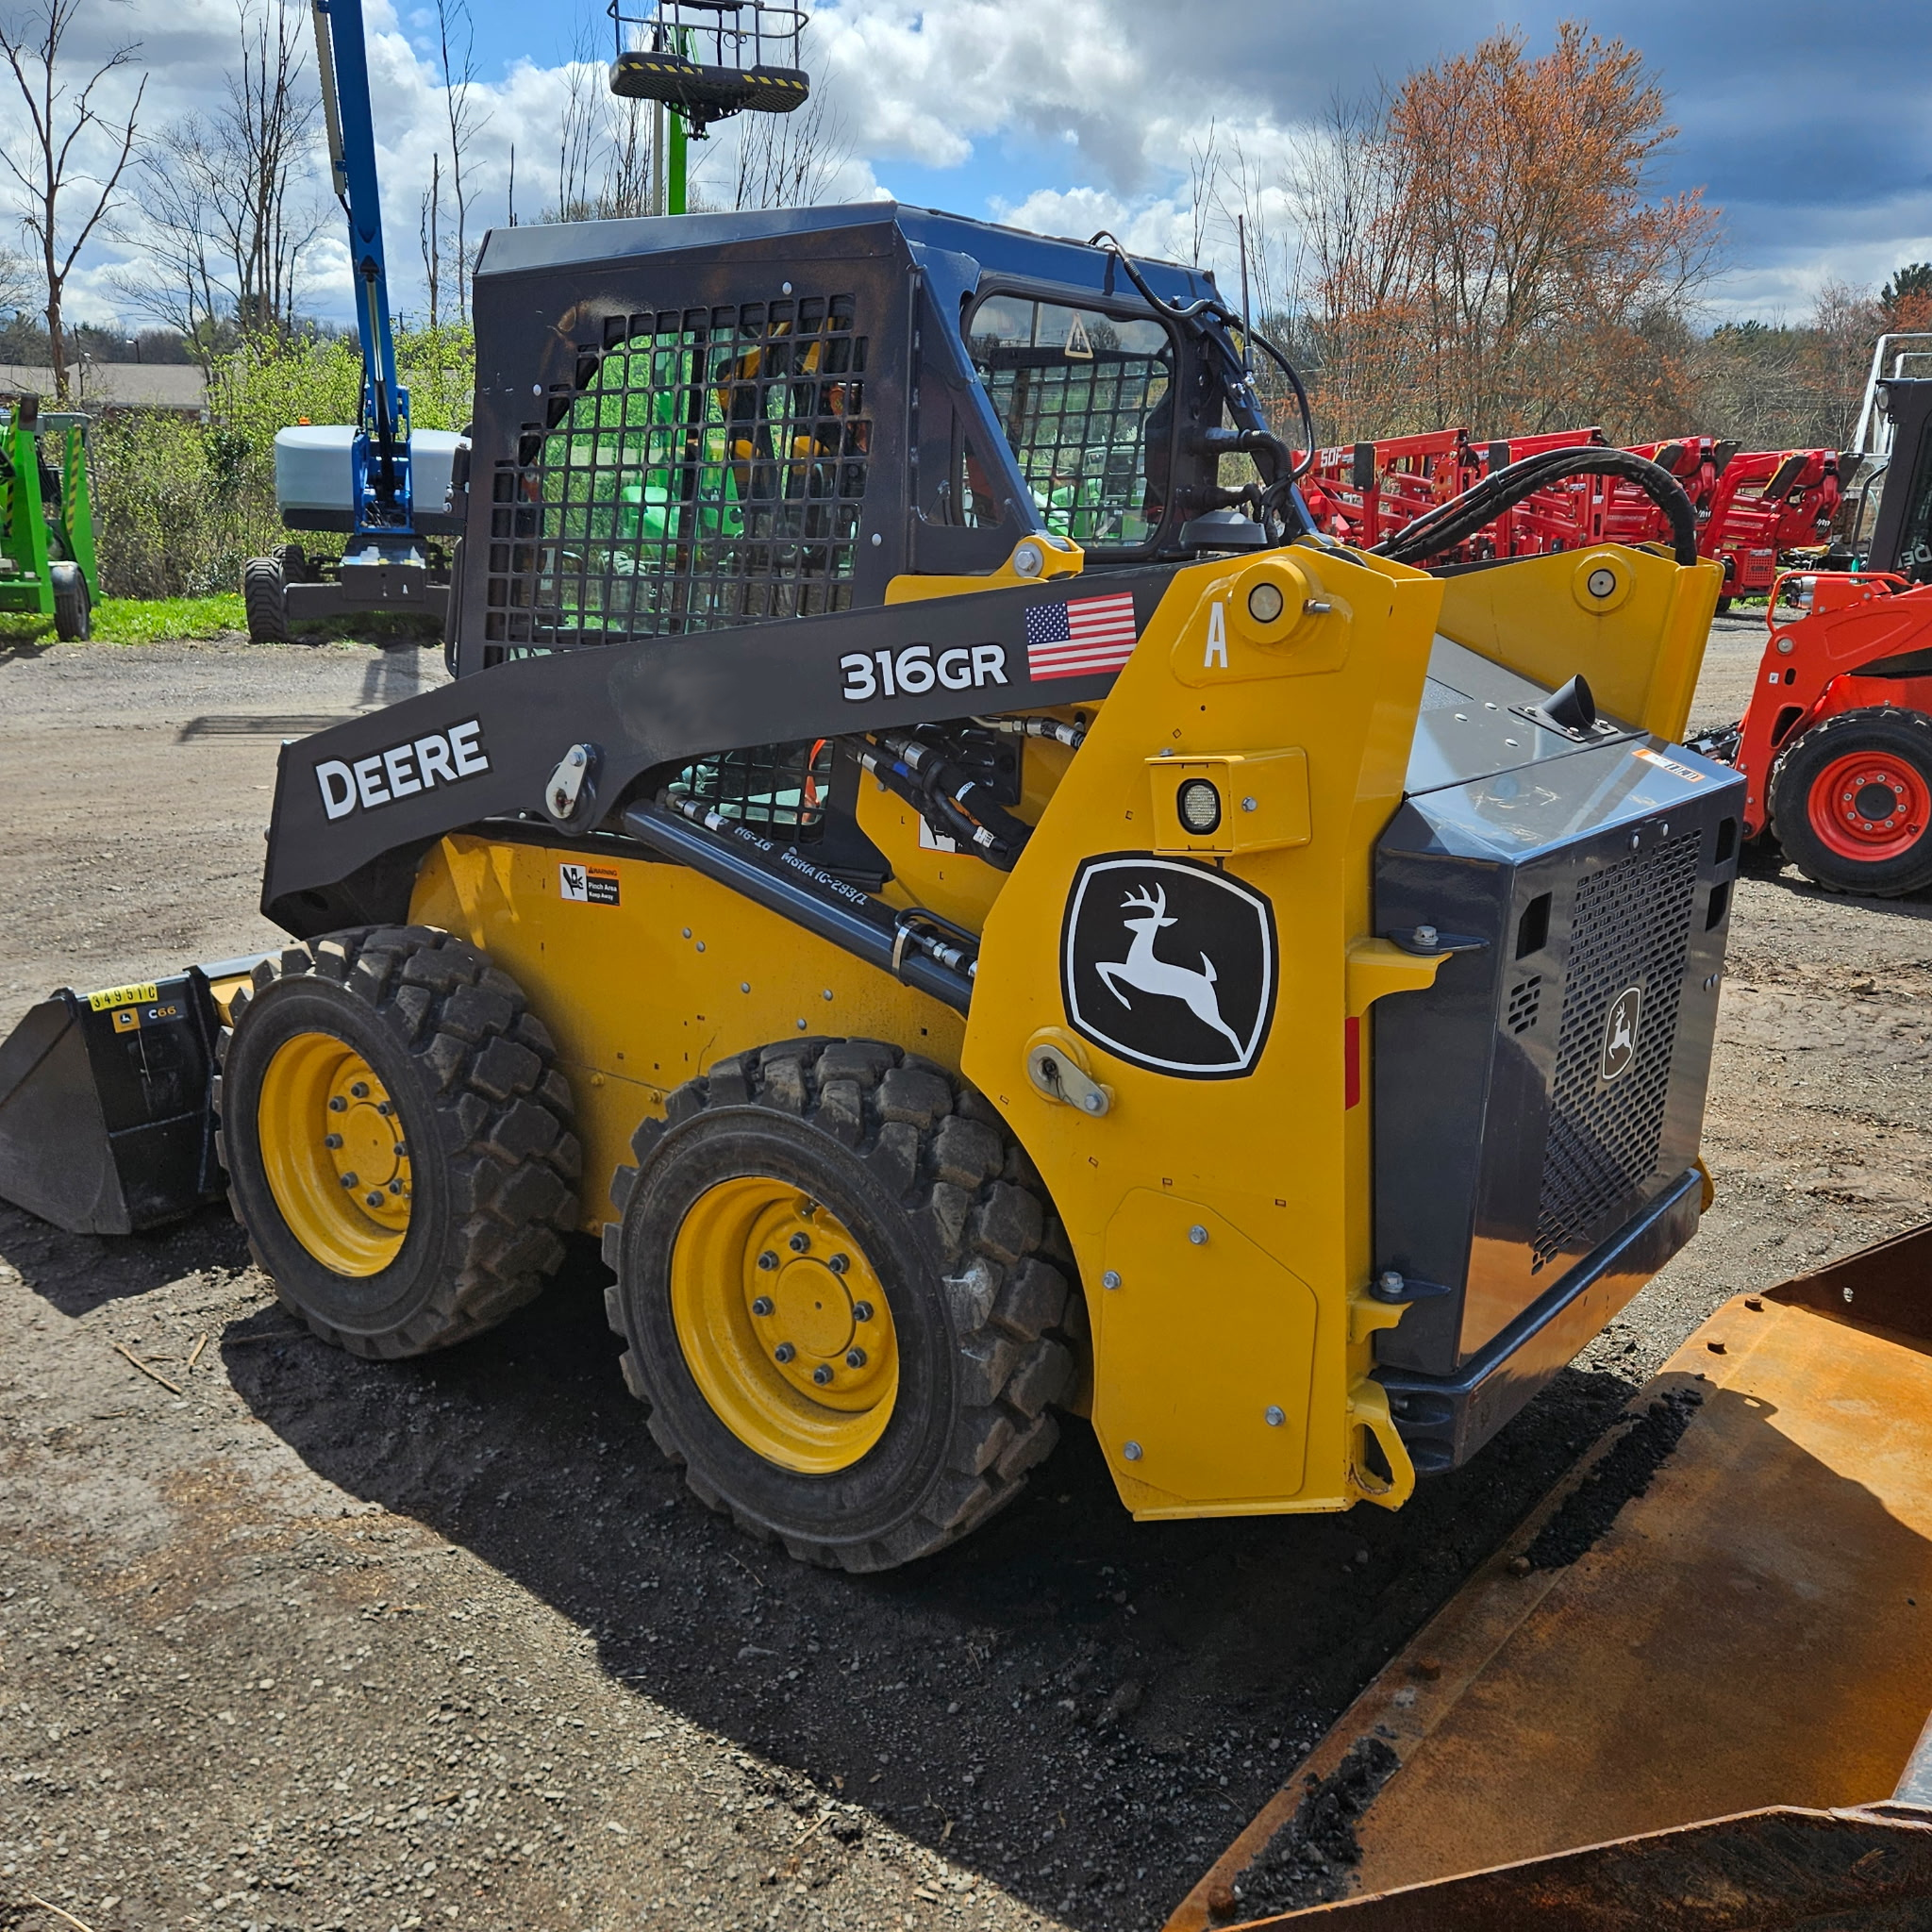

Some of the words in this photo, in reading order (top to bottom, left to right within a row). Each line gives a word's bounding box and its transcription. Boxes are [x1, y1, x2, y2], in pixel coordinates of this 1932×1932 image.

[1204, 602, 1227, 668] A
[840, 644, 1008, 700] 316GR
[316, 720, 489, 820] DEERE
[592, 868, 617, 876] WARNING
[734, 826, 774, 851] HG-16
[781, 852, 816, 876] MSHA
[148, 1006, 176, 1019] C66
